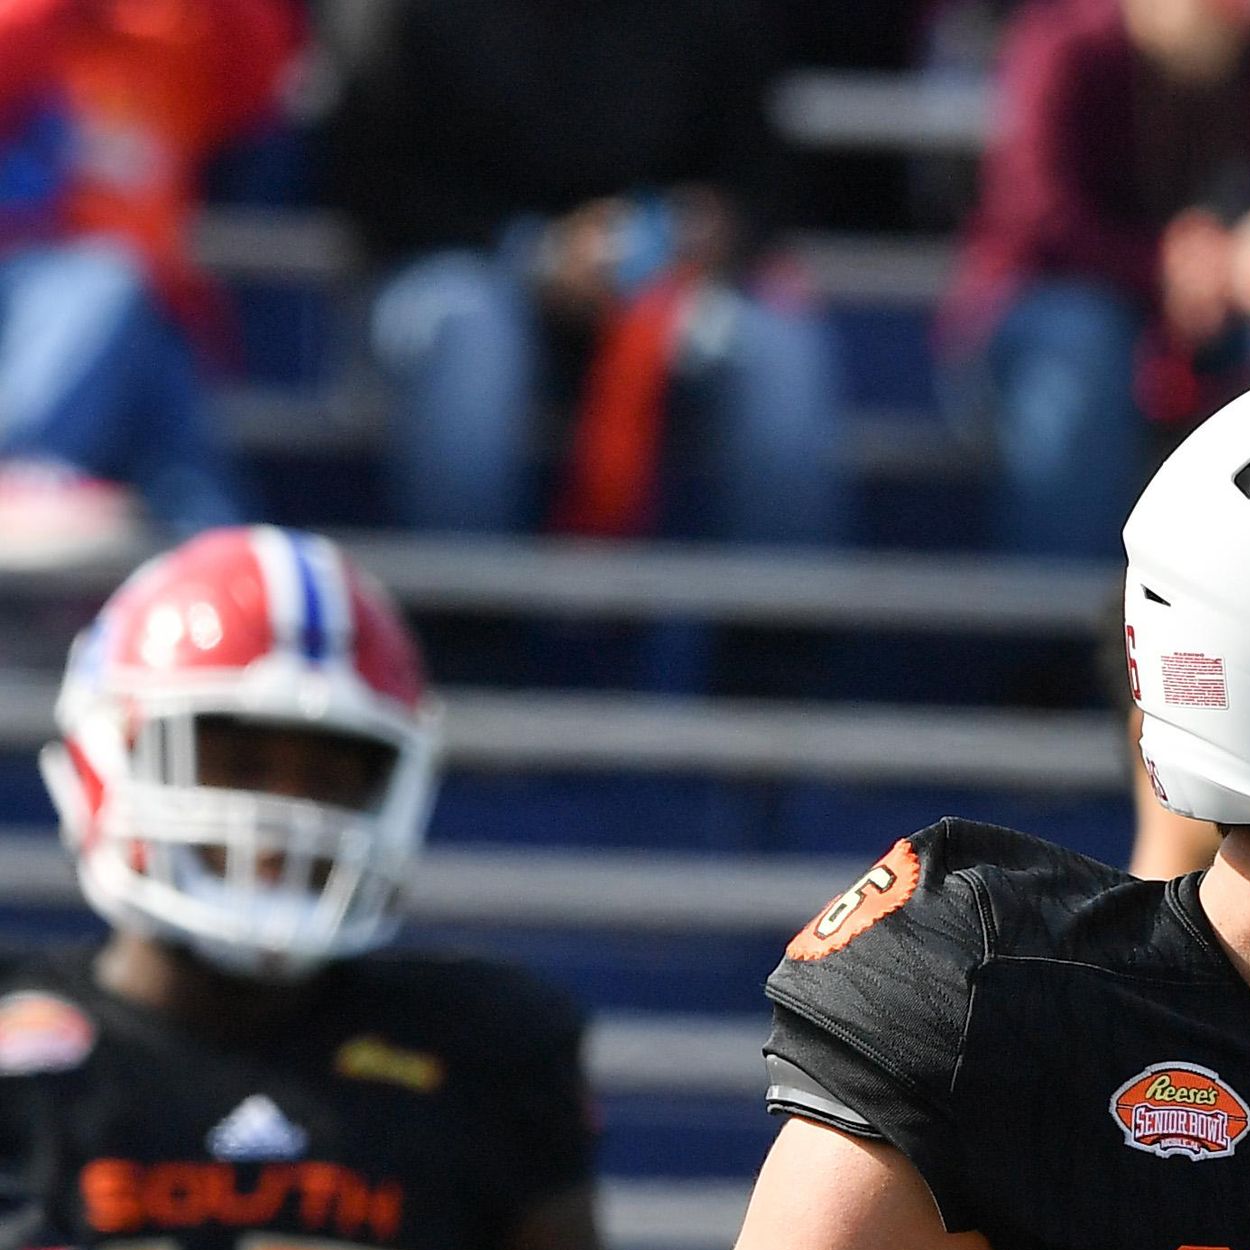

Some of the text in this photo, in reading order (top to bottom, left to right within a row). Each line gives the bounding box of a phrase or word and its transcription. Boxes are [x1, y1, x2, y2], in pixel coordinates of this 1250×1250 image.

[813, 864, 897, 940] 6
[1145, 1074, 1218, 1105] Reese's
[1135, 1106, 1227, 1144] SENIOR BOWL
[80, 1158, 404, 1240] SOUTH
